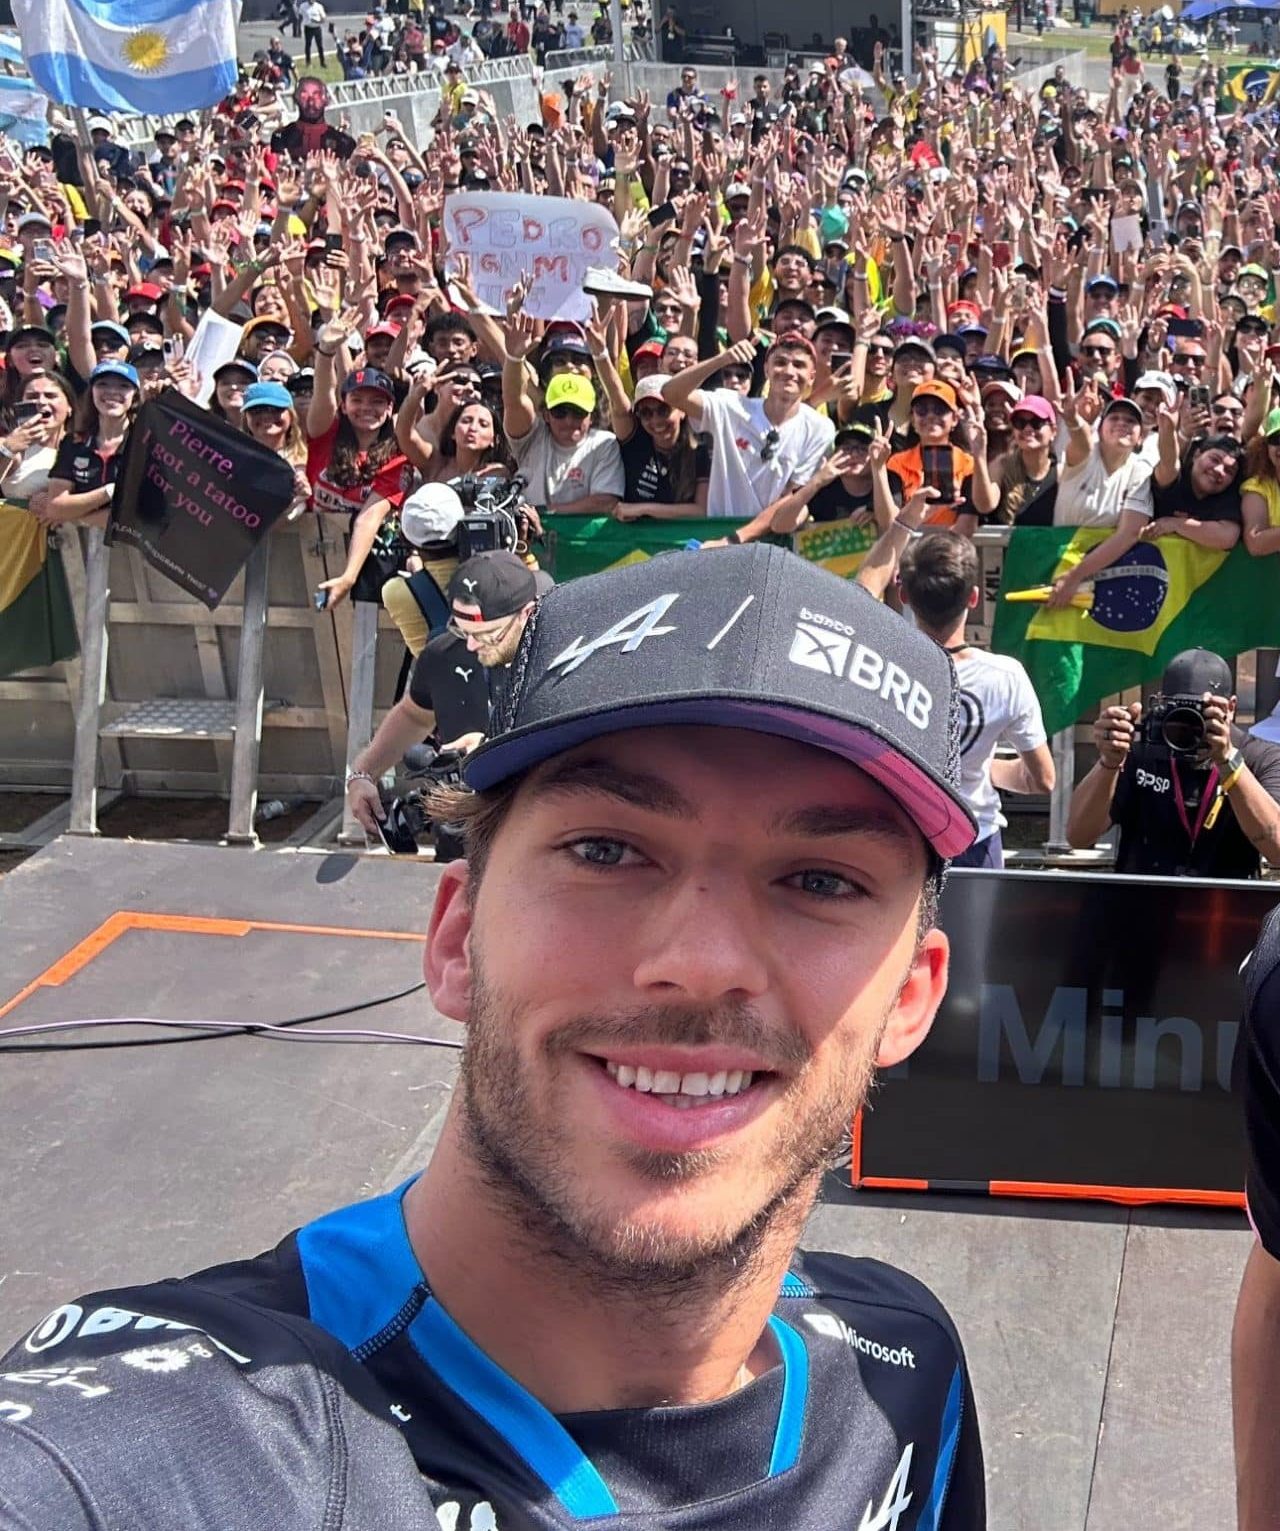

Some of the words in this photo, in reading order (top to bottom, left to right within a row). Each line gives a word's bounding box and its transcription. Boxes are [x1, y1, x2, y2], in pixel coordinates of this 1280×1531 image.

[452, 206, 604, 252] PEDRO
[141, 430, 152, 445] I
[151, 444, 184, 474] got
[187, 472, 200, 487] a
[204, 482, 261, 528] tatoo
[168, 419, 233, 481] Pierre,
[147, 464, 174, 494] for
[175, 492, 214, 528] you
[800, 607, 856, 636] banco
[849, 643, 933, 730] BRB
[839, 1320, 916, 1369] Microsoft
